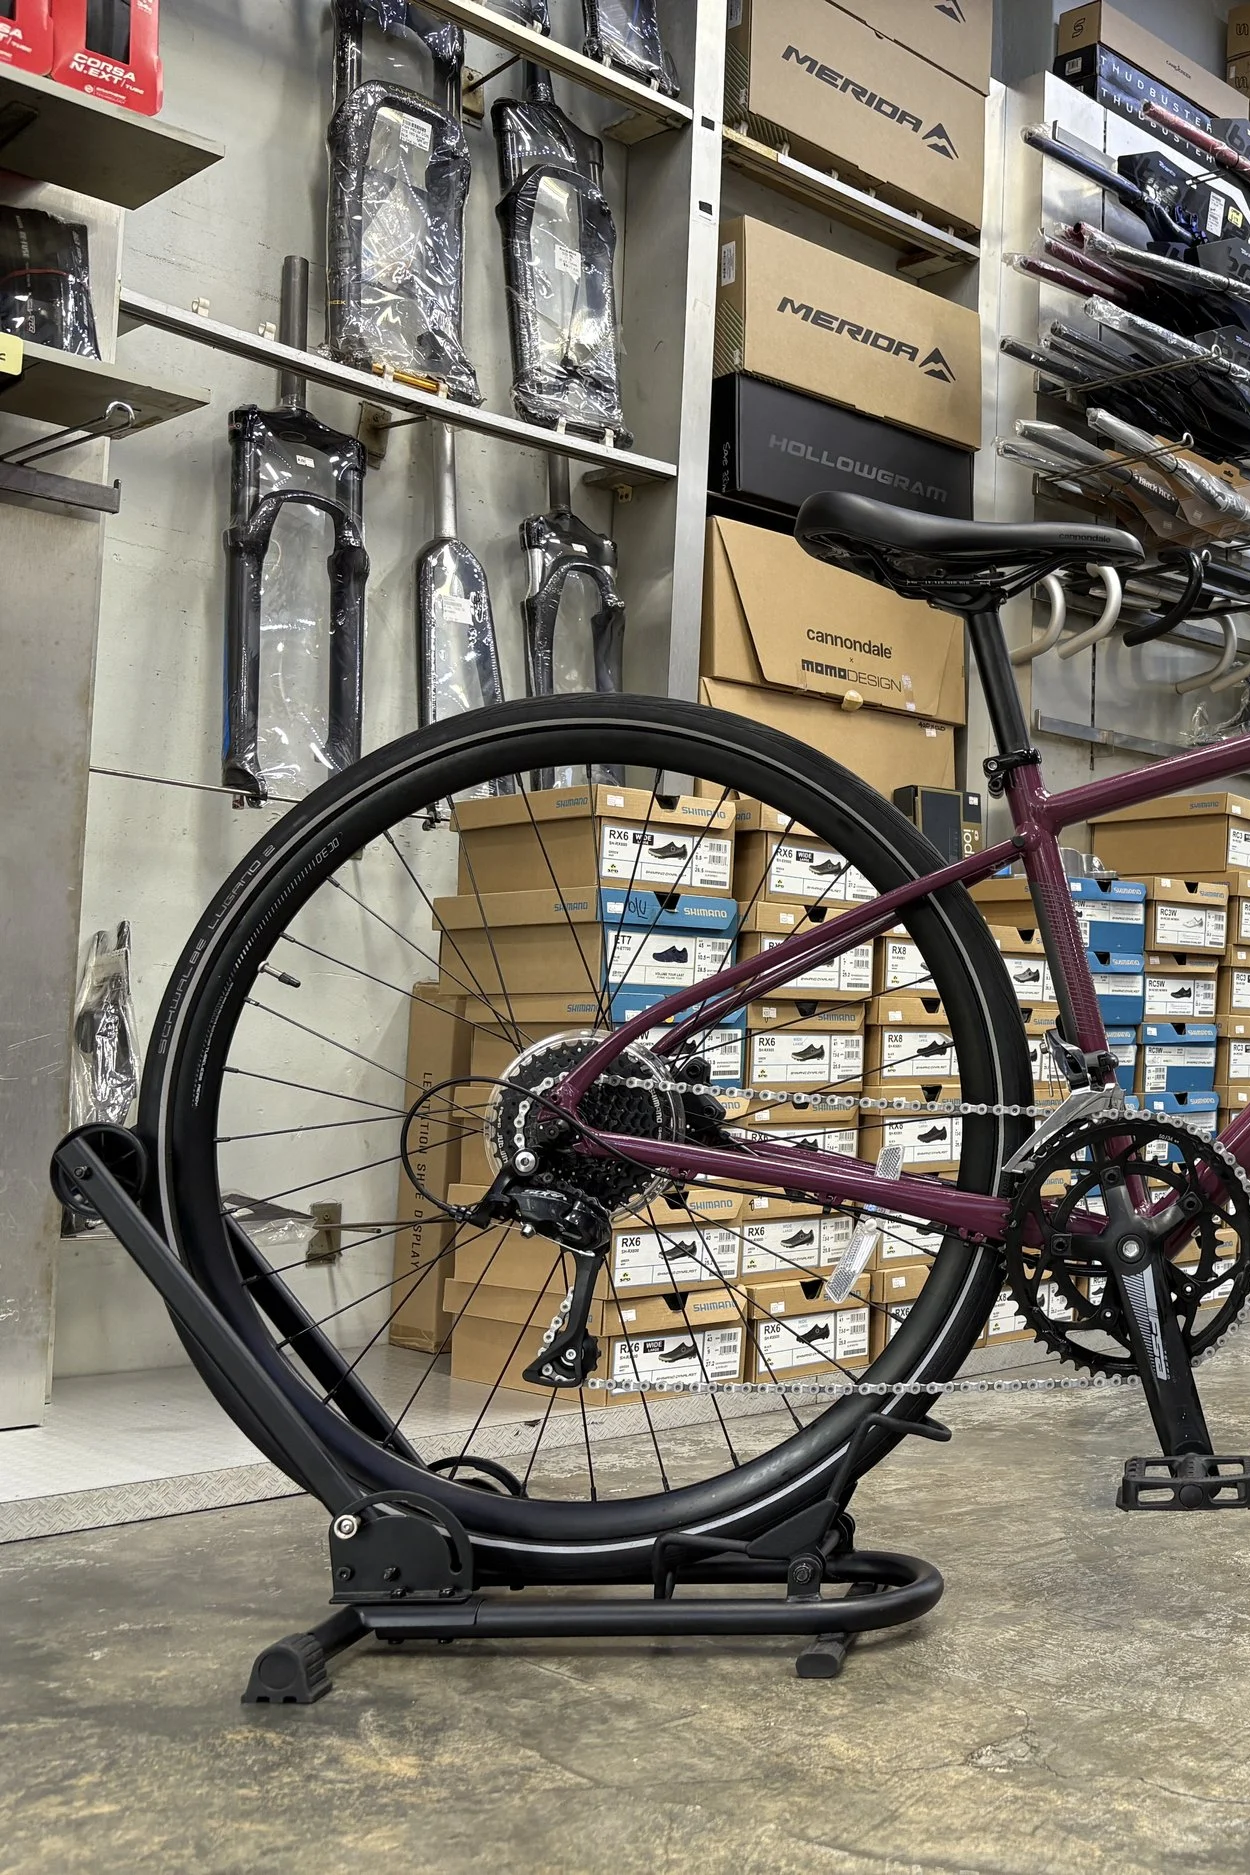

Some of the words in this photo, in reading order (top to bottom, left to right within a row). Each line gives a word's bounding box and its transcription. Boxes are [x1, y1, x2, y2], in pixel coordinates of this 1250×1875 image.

[72, 52, 136, 82] CORSA
[69, 62, 123, 85] N.EXT
[781, 45, 923, 133] MERIDA
[1100, 55, 1212, 133] THUDBUSTER
[777, 296, 920, 363] MERIDA
[768, 434, 948, 503] HOLLOWGRAM
[1059, 533, 1111, 544] cannondale
[807, 628, 892, 659] cannondale
[555, 797, 588, 808] SHIMANO
[681, 806, 726, 819] SHIMANO
[609, 829, 629, 840] RX6
[262, 844, 276, 856] 2
[777, 849, 793, 858] RX6
[208, 861, 261, 930] LUGANO
[553, 901, 588, 912] SHIMANO
[684, 908, 727, 918] SHIMANO
[614, 935, 632, 945] ET7
[158, 939, 206, 1054] SCHWALBE
[818, 1013, 856, 1022] SHIMANO
[758, 1038, 776, 1047] RX6
[888, 1034, 903, 1043] RX8
[690, 1199, 733, 1210] SHIMANO
[748, 1227, 765, 1237] RX6
[621, 1237, 641, 1247] RX6
[764, 1323, 781, 1334] RX6
[620, 1342, 640, 1354] RX6
